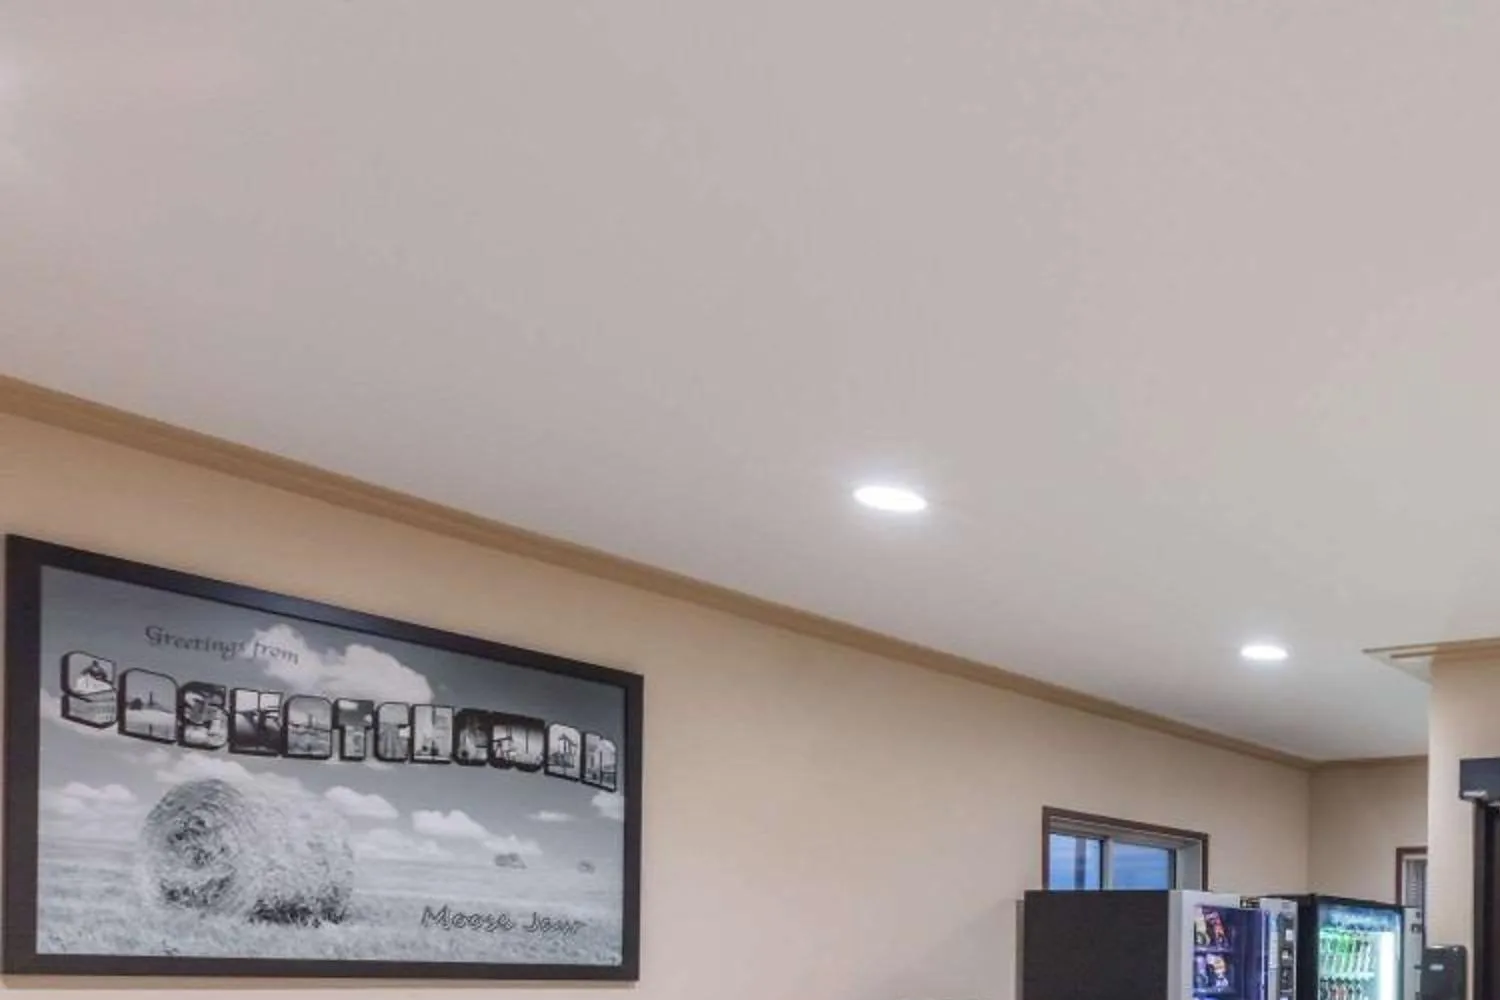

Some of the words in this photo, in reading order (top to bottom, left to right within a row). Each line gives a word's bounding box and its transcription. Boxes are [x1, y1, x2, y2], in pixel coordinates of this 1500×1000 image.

[144, 625, 246, 659] Greetings
[249, 641, 300, 665] from
[421, 905, 515, 932] Moose
